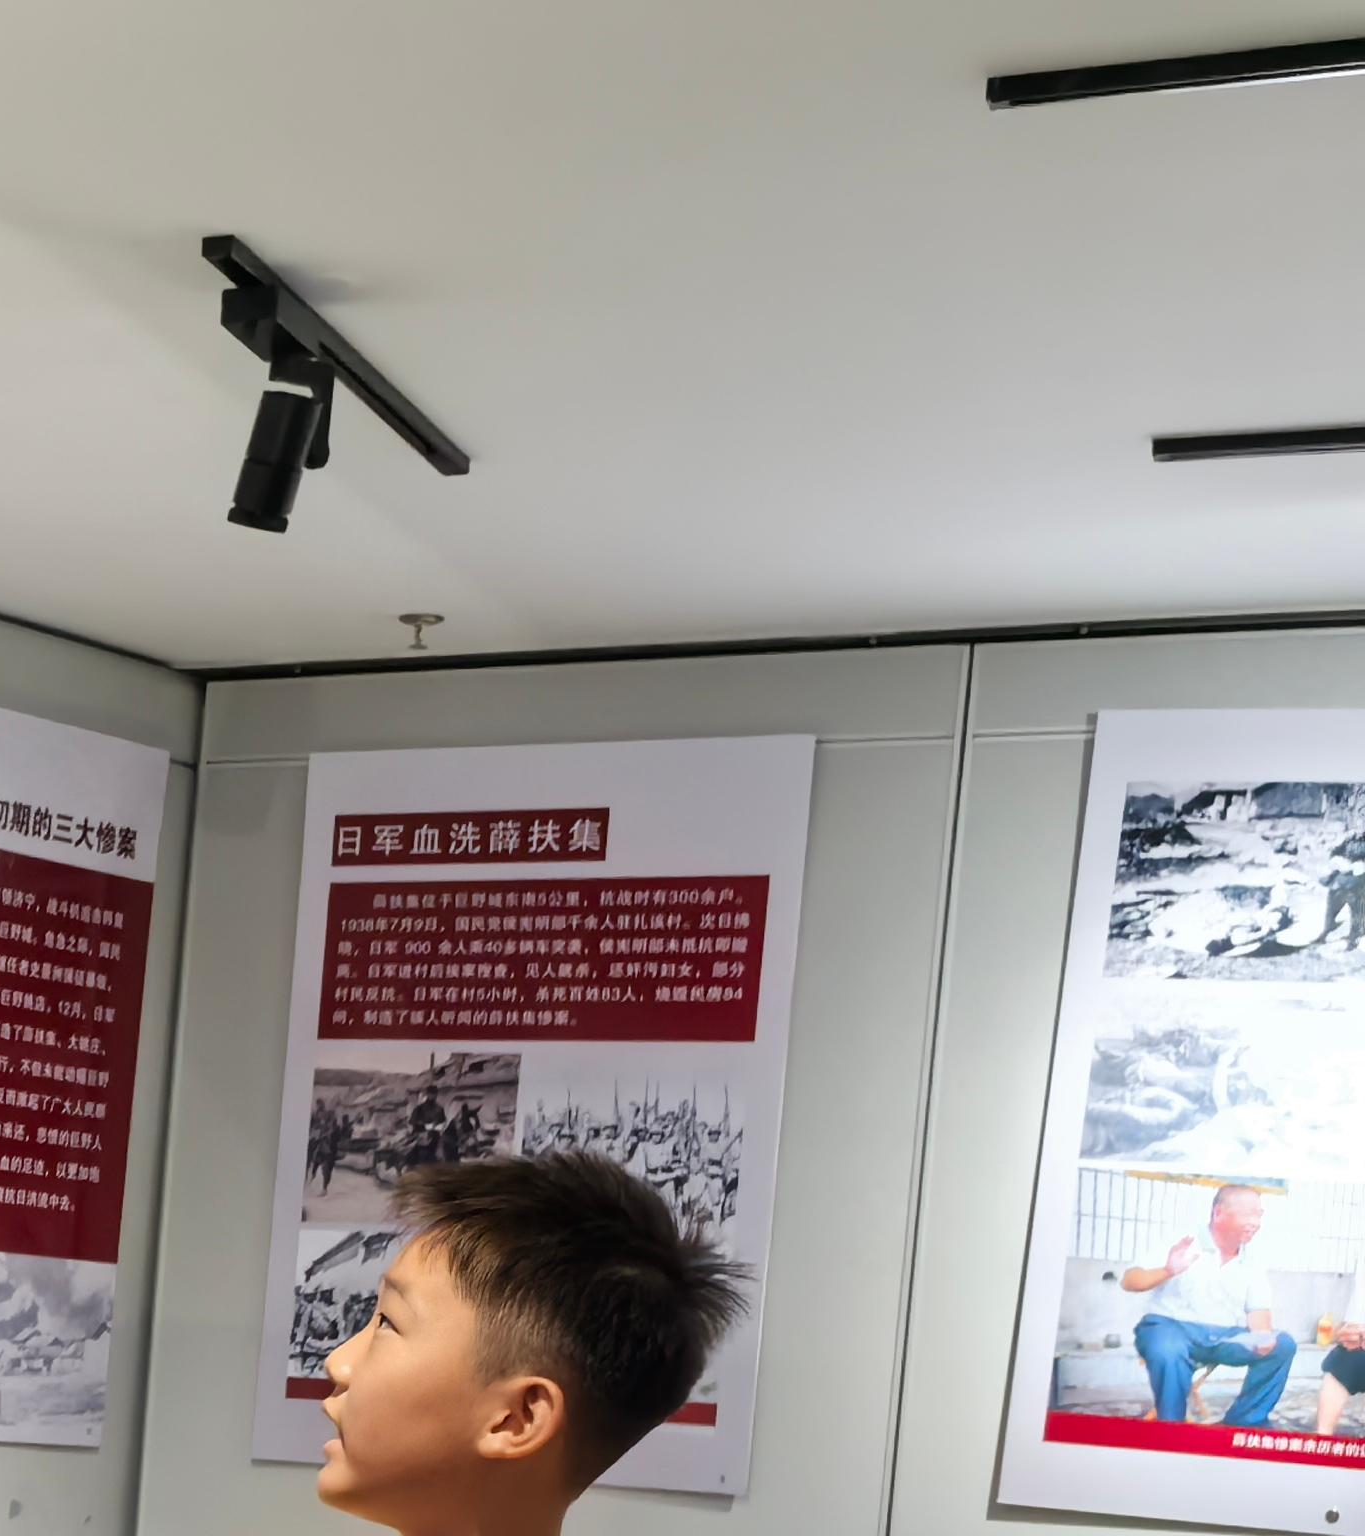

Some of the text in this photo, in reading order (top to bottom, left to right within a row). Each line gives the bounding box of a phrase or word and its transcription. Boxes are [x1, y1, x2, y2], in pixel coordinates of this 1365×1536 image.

[336, 818, 603, 857] 日军血洗薛扶集
